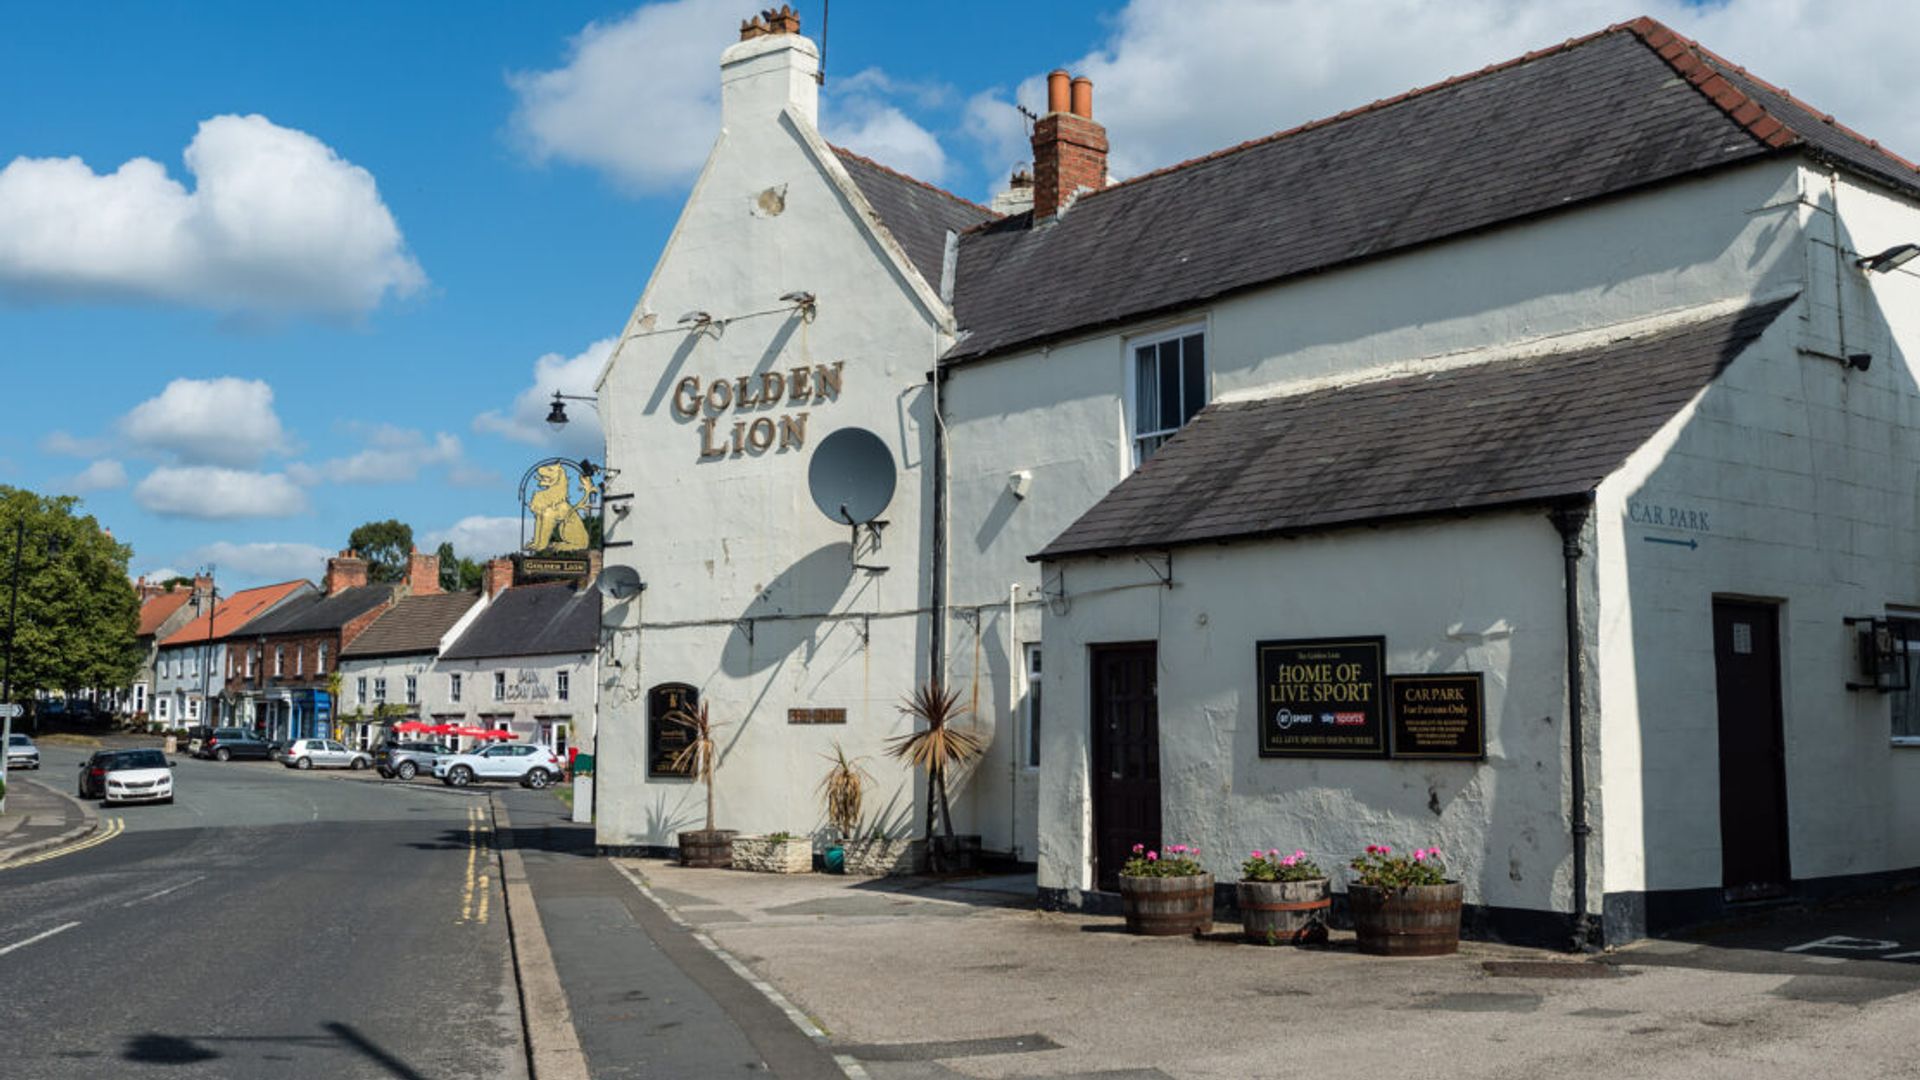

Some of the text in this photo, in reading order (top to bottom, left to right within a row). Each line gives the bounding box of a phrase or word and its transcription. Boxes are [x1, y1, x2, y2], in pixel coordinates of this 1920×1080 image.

[674, 361, 844, 416] GOLDEN
[701, 412, 810, 457] LION
[1629, 502, 1710, 531] CAR PARK
[1279, 663, 1362, 682] HOME OF
[1271, 682, 1372, 702] LIVE SPORT
[1405, 688, 1465, 701] CAR PARK
[1293, 714, 1313, 723] SPORT
[1321, 713, 1335, 725] sky
[1448, 704, 1468, 717] Only
